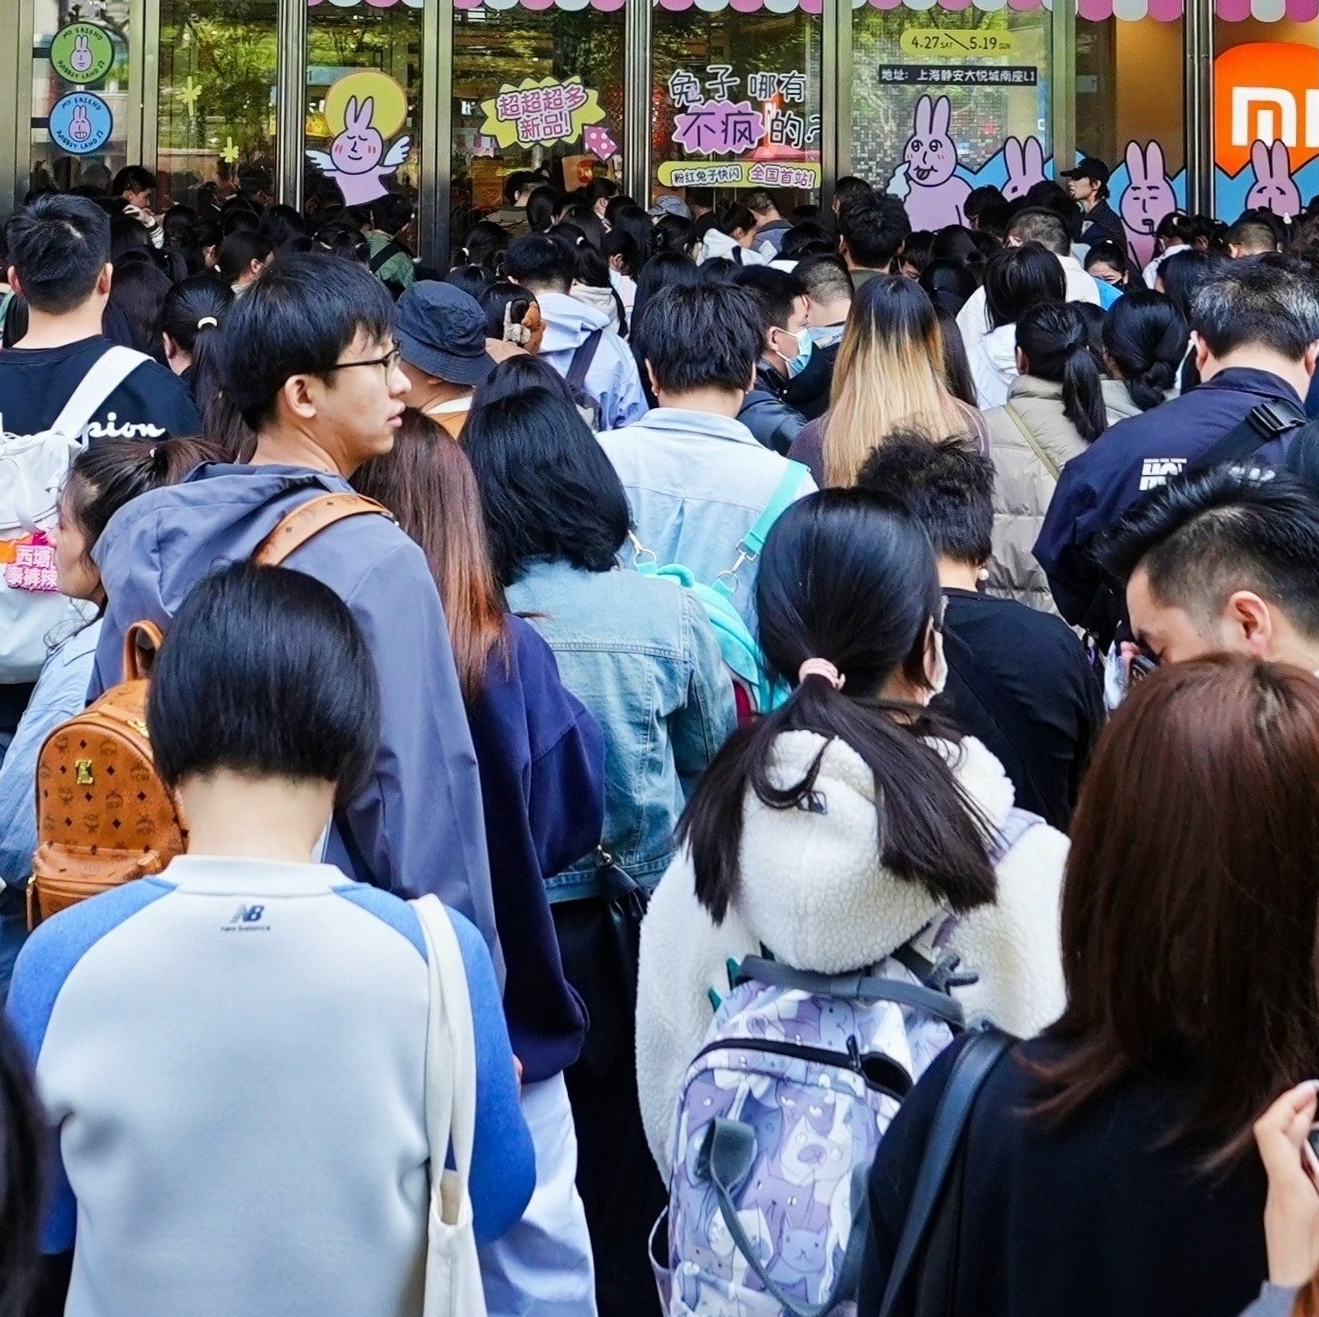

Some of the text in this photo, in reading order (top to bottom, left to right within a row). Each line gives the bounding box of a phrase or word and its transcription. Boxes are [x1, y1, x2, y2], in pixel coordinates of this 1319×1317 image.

[911, 36, 940, 49] 4.27
[969, 36, 997, 50] 5.19
[669, 65, 807, 107] 兔子 哪有
[917, 69, 1035, 82] 上海静安大悦城南座L1
[499, 85, 585, 118] 超超超多
[682, 110, 756, 147] 不疯
[674, 167, 741, 185] 粉红兔子快闪
